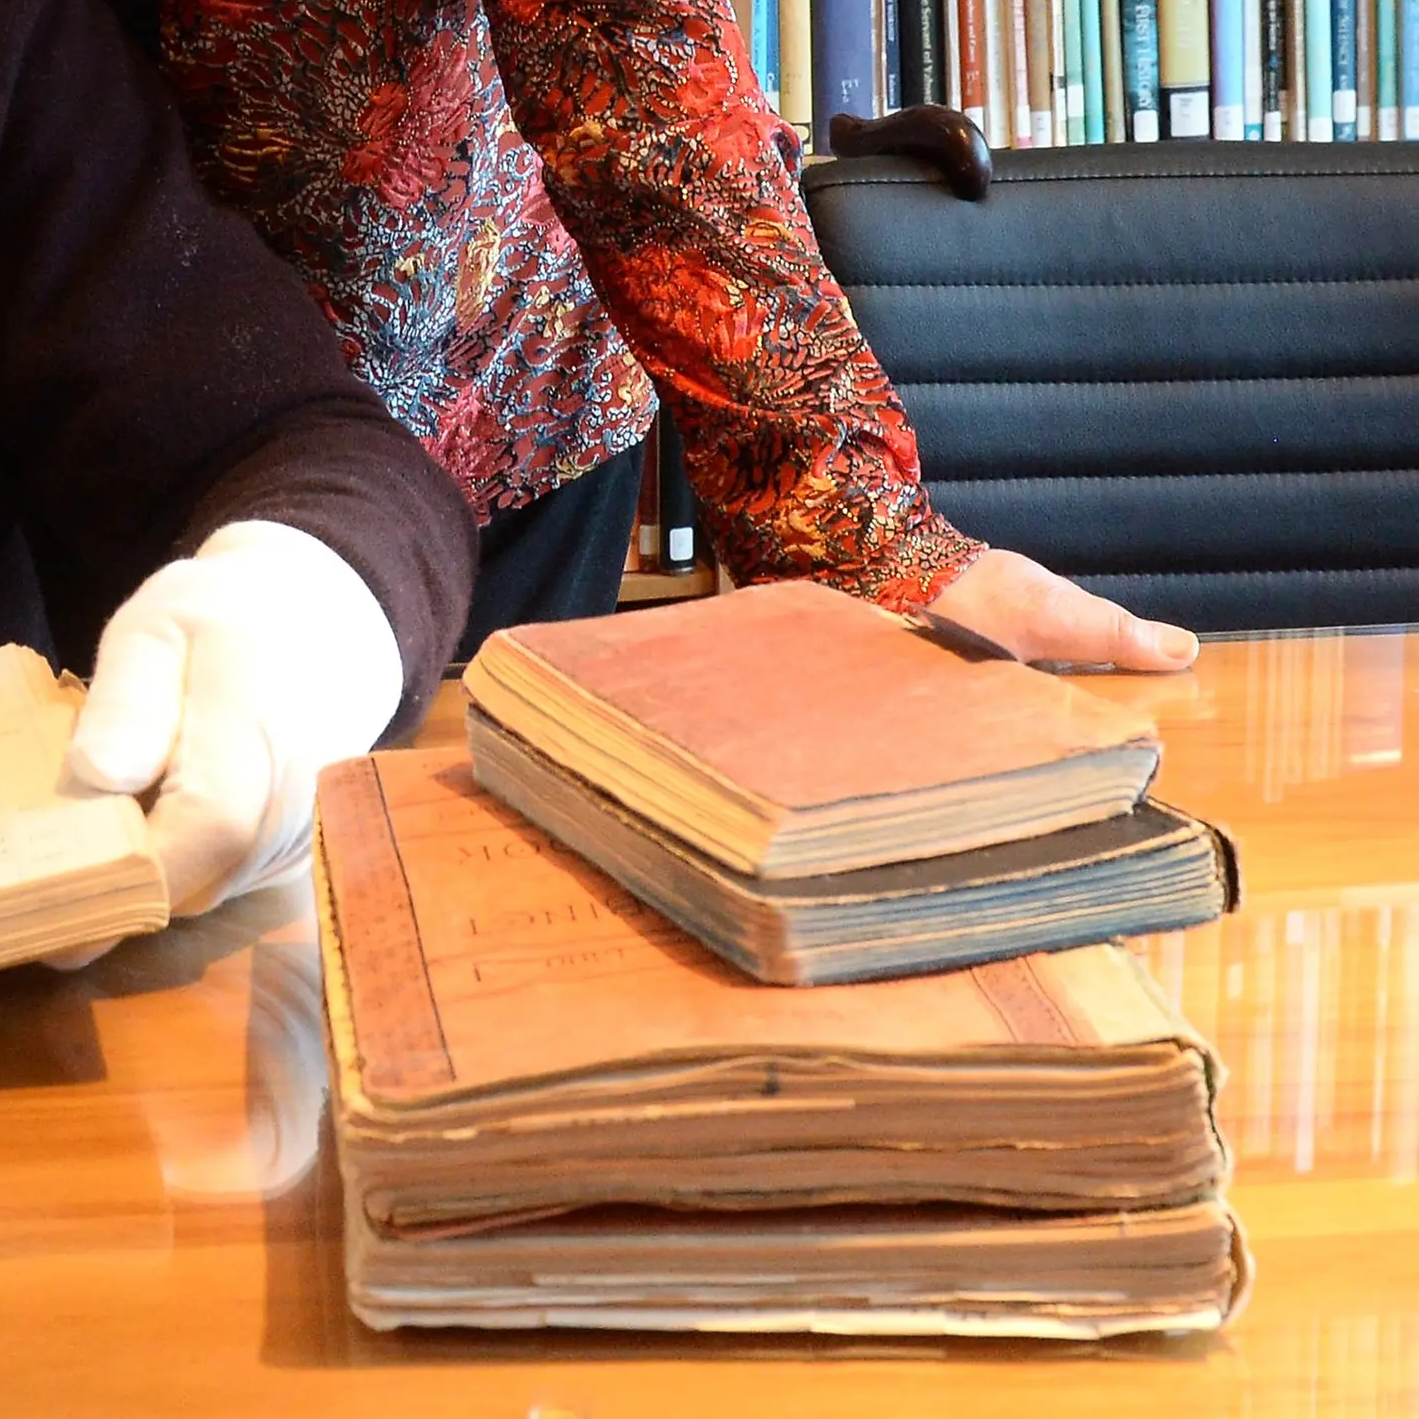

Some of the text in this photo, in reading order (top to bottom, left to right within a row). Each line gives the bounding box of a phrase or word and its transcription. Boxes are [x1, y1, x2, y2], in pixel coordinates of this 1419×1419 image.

[921, 5, 933, 50] Servant
[1135, 4, 1154, 41] FIRST
[1338, 15, 1352, 65] SILENCE
[923, 52, 934, 64] of
[1137, 49, 1156, 109] HISTORY
